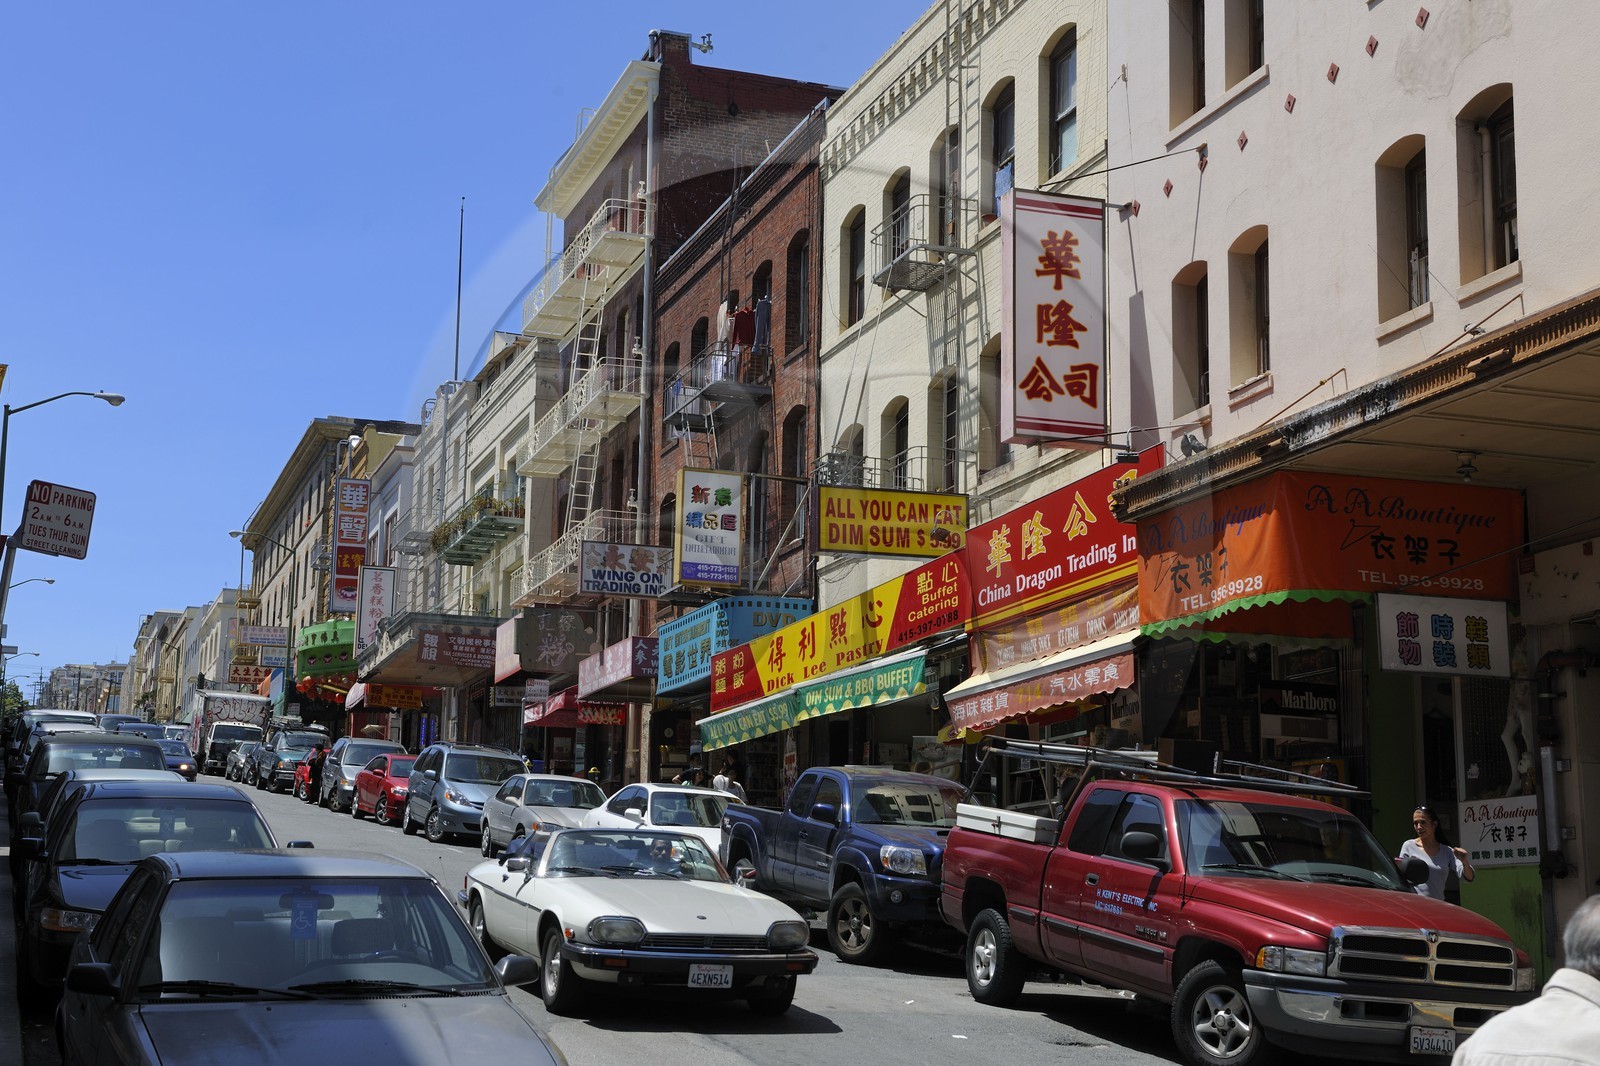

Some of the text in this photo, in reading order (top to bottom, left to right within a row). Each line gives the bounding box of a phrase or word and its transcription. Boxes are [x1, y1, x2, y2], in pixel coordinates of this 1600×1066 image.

[1019, 230, 1099, 409] 華隆公司
[31, 484, 93, 511] NO PARKING
[32, 507, 39, 519] 2
[64, 515, 71, 526] 6
[826, 498, 961, 525] ALL YOU CAN EAT
[1191, 502, 1266, 541] Boutique
[1378, 496, 1497, 534] Boutique
[26, 539, 81, 556] STREET CLEANING
[29, 524, 86, 546] TUES THUR SUN
[696, 535, 726, 544] GIFT
[829, 523, 863, 545] DIM
[870, 526, 909, 548] SUM
[1371, 532, 1460, 565] 衣架子
[686, 544, 736, 555] ENTERTAINMENT
[584, 580, 641, 593] TRADING
[592, 569, 663, 584] WING ON
[917, 562, 958, 595] 點心
[978, 583, 1010, 607] China
[1017, 563, 1061, 592] Dragon
[1067, 544, 1116, 574] Trading
[922, 582, 957, 604] Buffet
[753, 612, 796, 627] DVD
[908, 595, 958, 622] Catering
[769, 600, 883, 673] 得利點心
[1086, 616, 1107, 638] DRINKS
[1396, 612, 1421, 665] 飾物
[1431, 614, 1457, 667] 時裝
[1465, 616, 1491, 669] 鞋類
[663, 638, 711, 678] 電影世界
[767, 638, 883, 692] Dick Lee Pastry
[806, 666, 913, 706] DIM SUM & BBQ BUFFET
[1050, 663, 1119, 695] 汽水零食
[952, 692, 1009, 721] 海味雜貨
[1111, 696, 1140, 720] Marlboro
[1281, 689, 1336, 712] Marlboro
[710, 703, 788, 739] ALL YOU CAN EAT $5.99
[1491, 826, 1527, 842] 衣架子
[1102, 889, 1121, 902] KENT'S
[1122, 894, 1145, 907] ELECTRIC
[691, 973, 729, 985] 4EXN514
[1414, 1037, 1452, 1052] 5V34410
